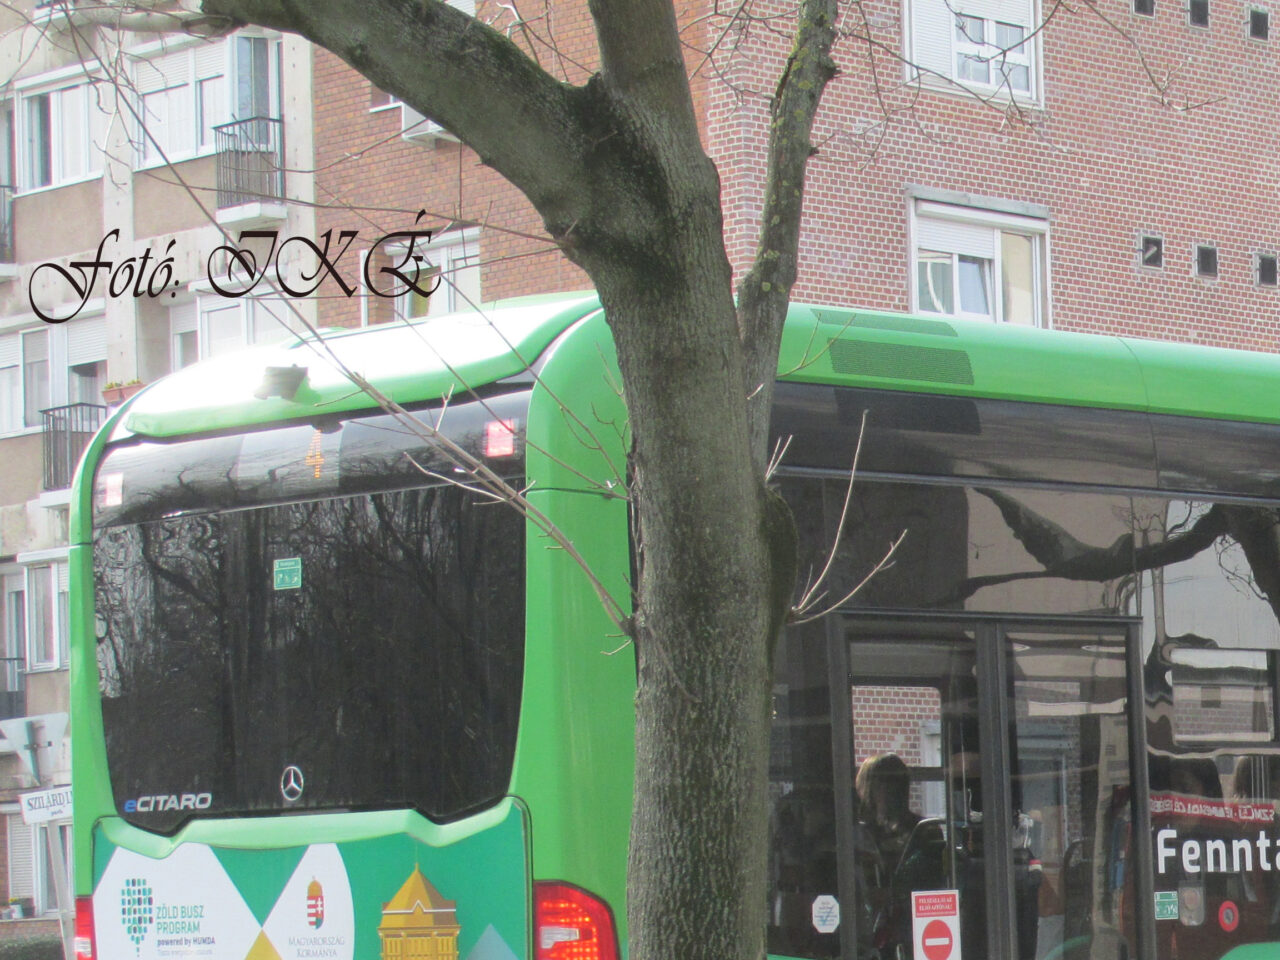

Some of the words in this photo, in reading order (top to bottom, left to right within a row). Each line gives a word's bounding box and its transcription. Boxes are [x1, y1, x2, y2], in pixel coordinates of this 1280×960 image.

[306, 429, 325, 478] 4
[124, 793, 212, 813] eCITARO
[156, 903, 178, 919] ZÖLD
[180, 905, 205, 919] BUSZ
[157, 921, 200, 935] PROGRAM
[157, 938, 183, 947] powered
[184, 937, 192, 947] by
[193, 936, 216, 945] HUMDA
